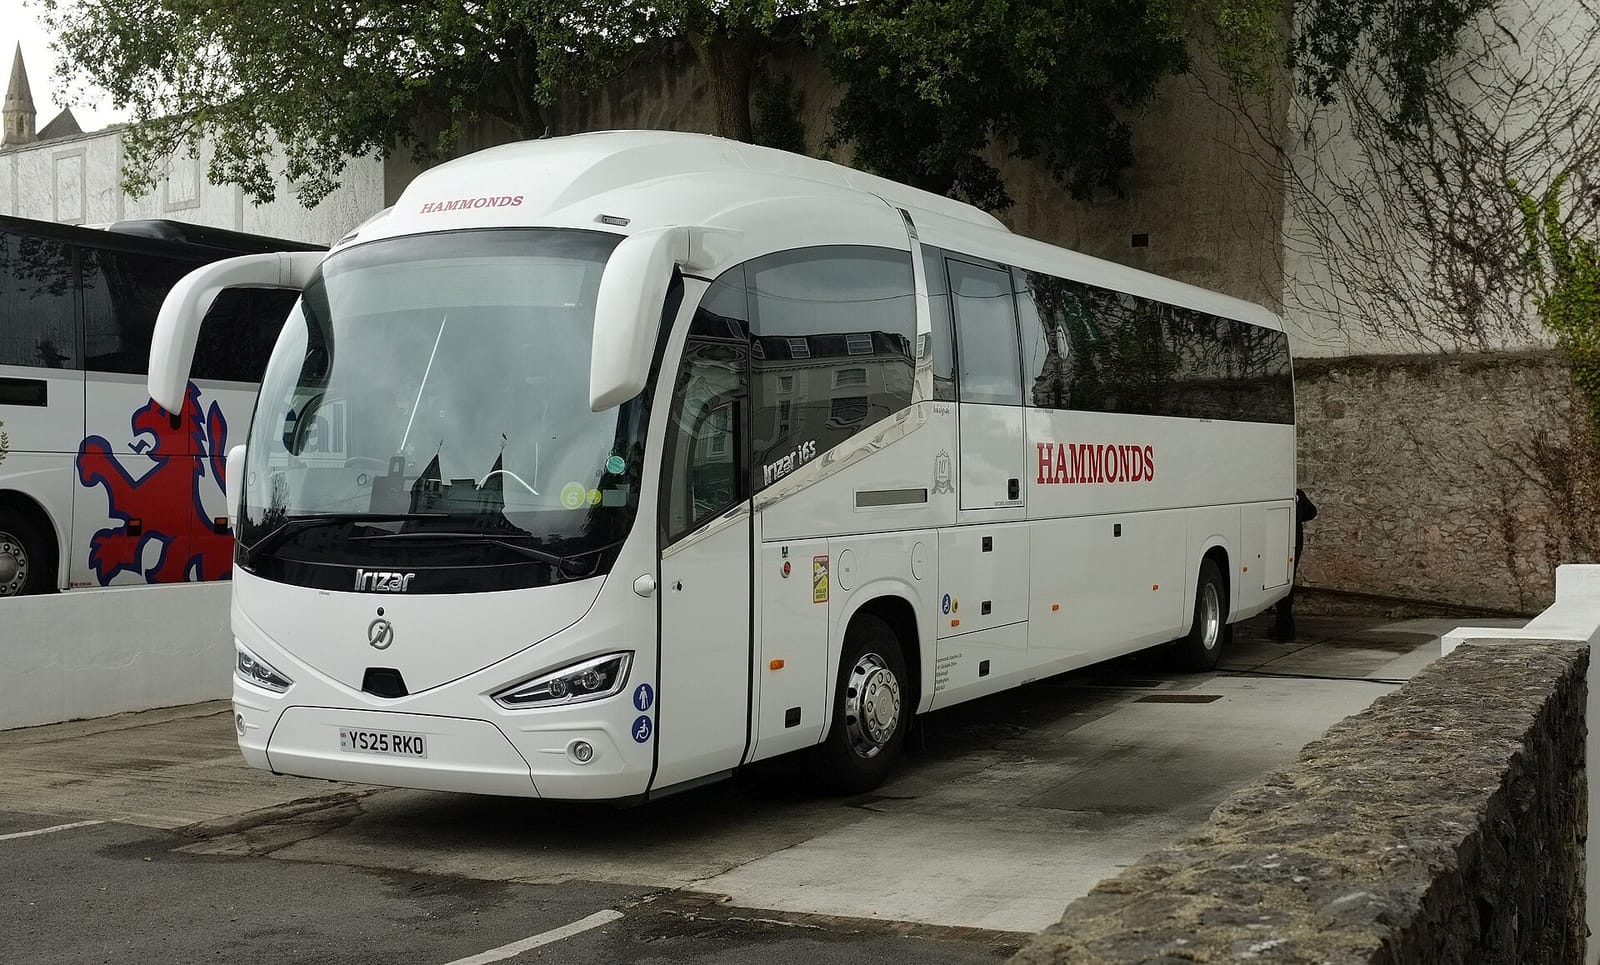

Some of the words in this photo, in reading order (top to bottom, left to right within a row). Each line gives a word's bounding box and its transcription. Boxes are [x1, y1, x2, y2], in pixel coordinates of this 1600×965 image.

[420, 195, 524, 214] HAMMONDS
[763, 451, 797, 486] Irizar
[1037, 442, 1155, 484] HAMMONDS
[354, 568, 416, 592] Irizar
[349, 730, 389, 752] YS25
[392, 734, 424, 755] RKO
